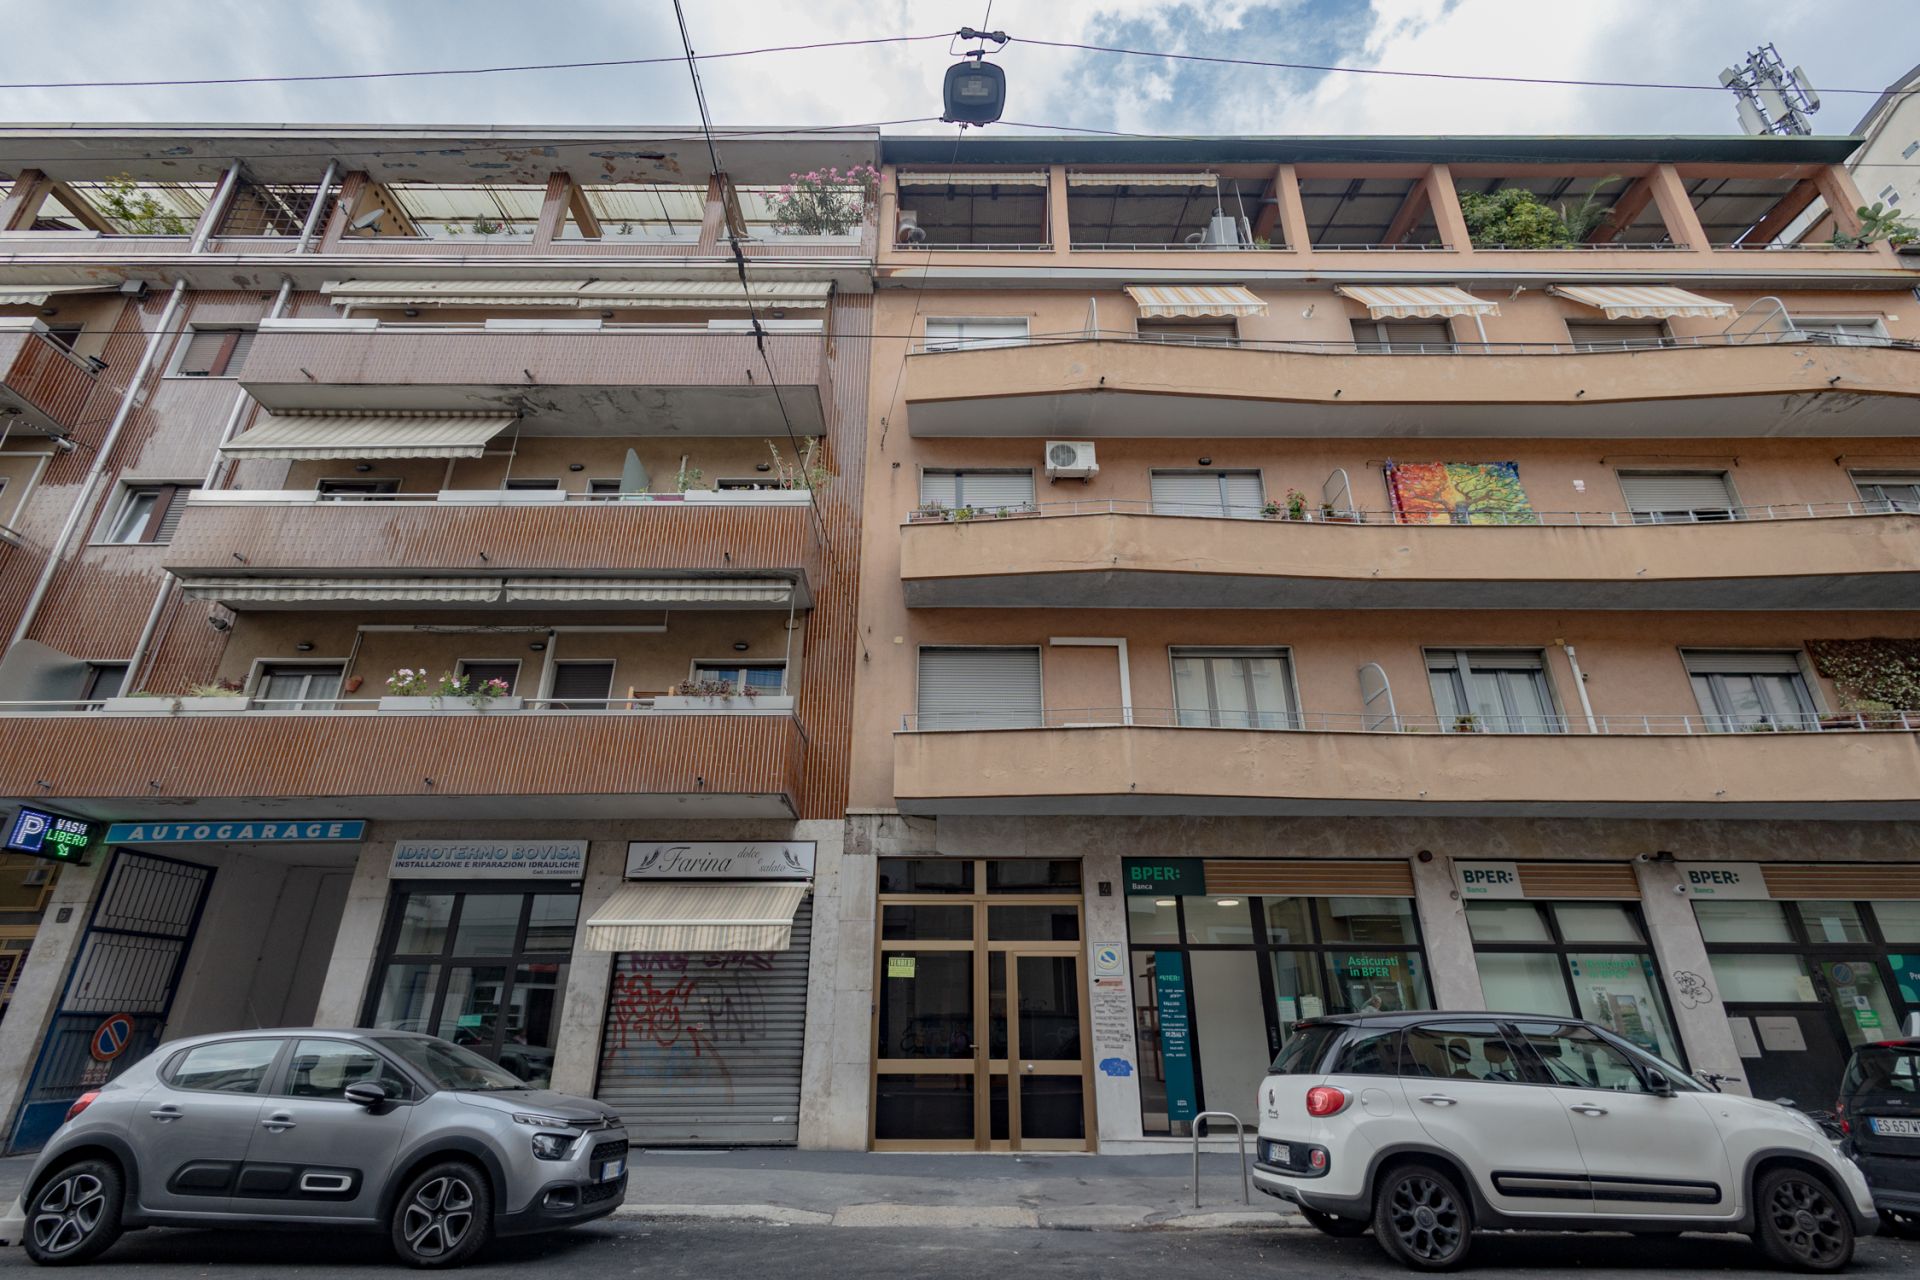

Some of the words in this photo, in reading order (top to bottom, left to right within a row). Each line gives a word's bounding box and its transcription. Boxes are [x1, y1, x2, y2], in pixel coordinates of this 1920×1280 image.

[16, 815, 45, 844] P
[55, 818, 88, 835] WASH
[128, 823, 343, 840] AUTOGARAGE
[45, 828, 88, 847] LIBERO
[396, 845, 508, 860] IDROTERMO
[511, 845, 581, 860] BOVISA
[658, 846, 734, 873] Farina
[1348, 956, 1399, 966] Assicurati
[1350, 967, 1360, 977] in
[1361, 967, 1389, 977] BPER
